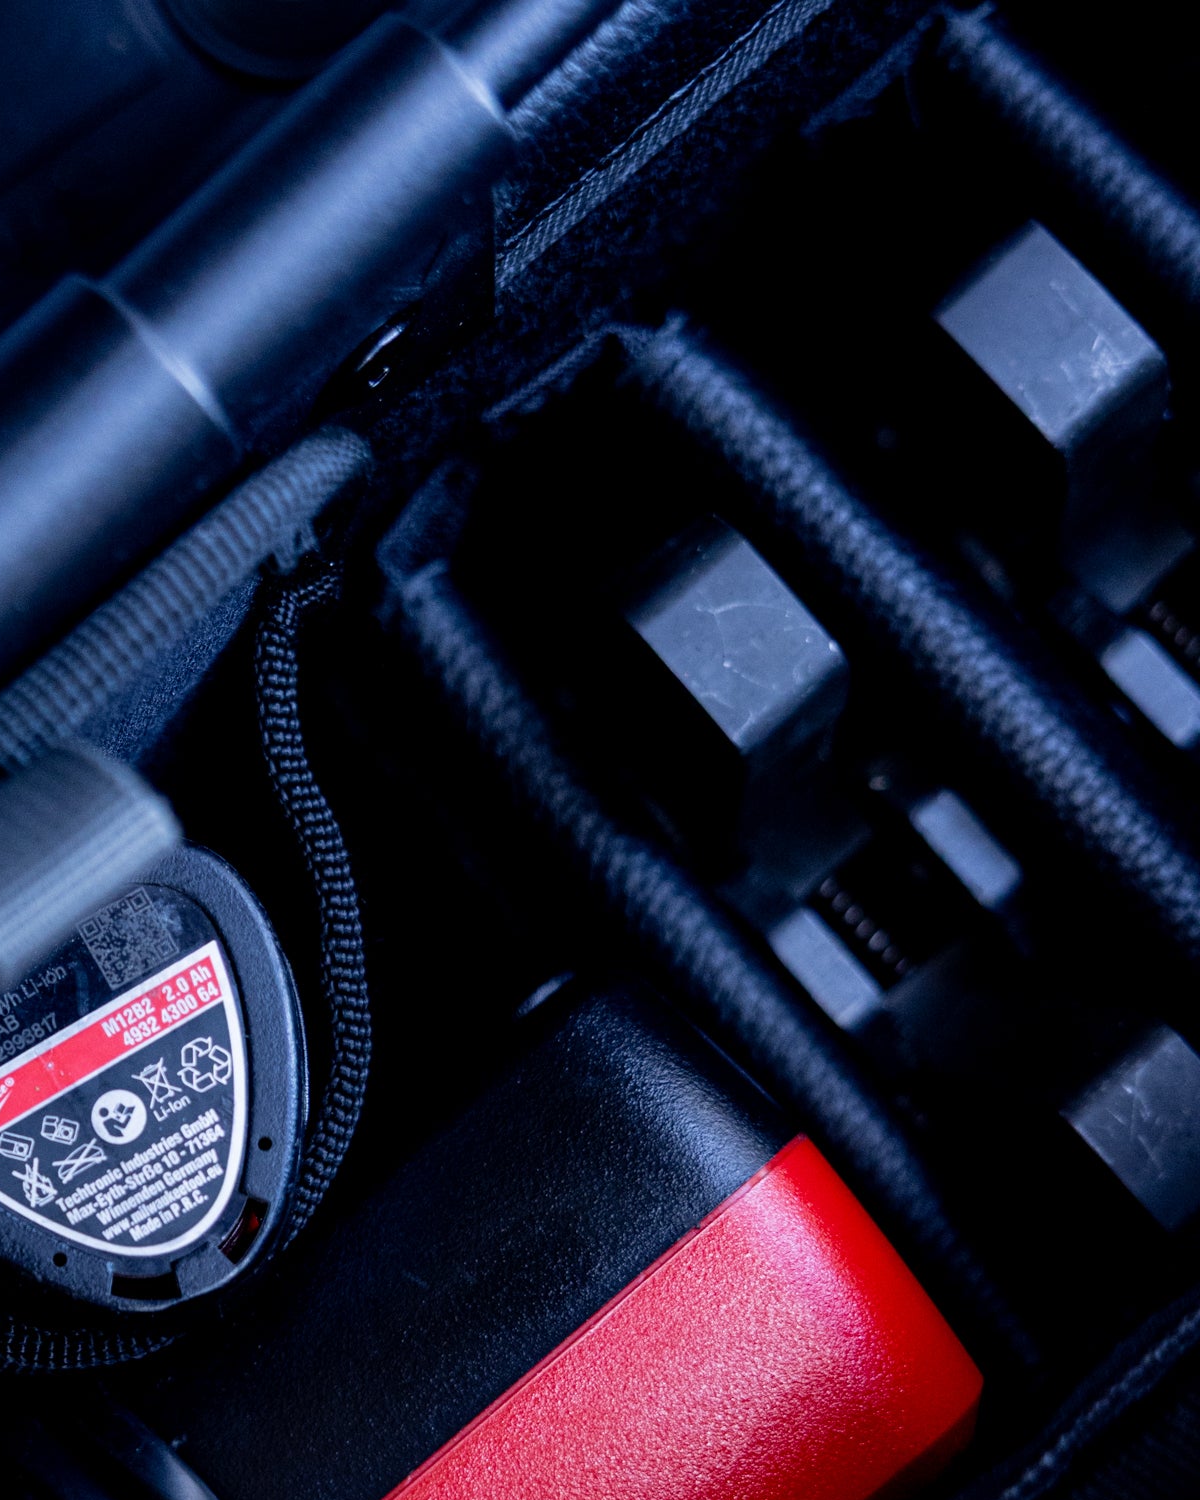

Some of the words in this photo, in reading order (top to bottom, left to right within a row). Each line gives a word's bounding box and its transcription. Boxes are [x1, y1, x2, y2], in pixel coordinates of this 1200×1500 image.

[101, 998, 155, 1037] M12B2
[161, 977, 190, 1002] 2.0
[189, 965, 212, 987] Ah
[123, 1016, 161, 1046] 4932
[161, 994, 198, 1024] 4300
[197, 981, 219, 1002] 64
[153, 1095, 191, 1122] Li-Ion
[55, 1168, 123, 1212] Techtronic
[120, 1133, 183, 1175] Industries
[180, 1108, 219, 1139] GmbH
[162, 1151, 181, 1168] 10
[184, 1124, 225, 1155] 71364
[96, 1179, 164, 1226] Winnenden
[162, 1149, 219, 1187] Germany
[101, 1163, 224, 1241] www.milwaukeetool.eu
[128, 1216, 163, 1242] Made
[158, 1209, 173, 1225] in
[170, 1189, 209, 1218] P.R.C.
